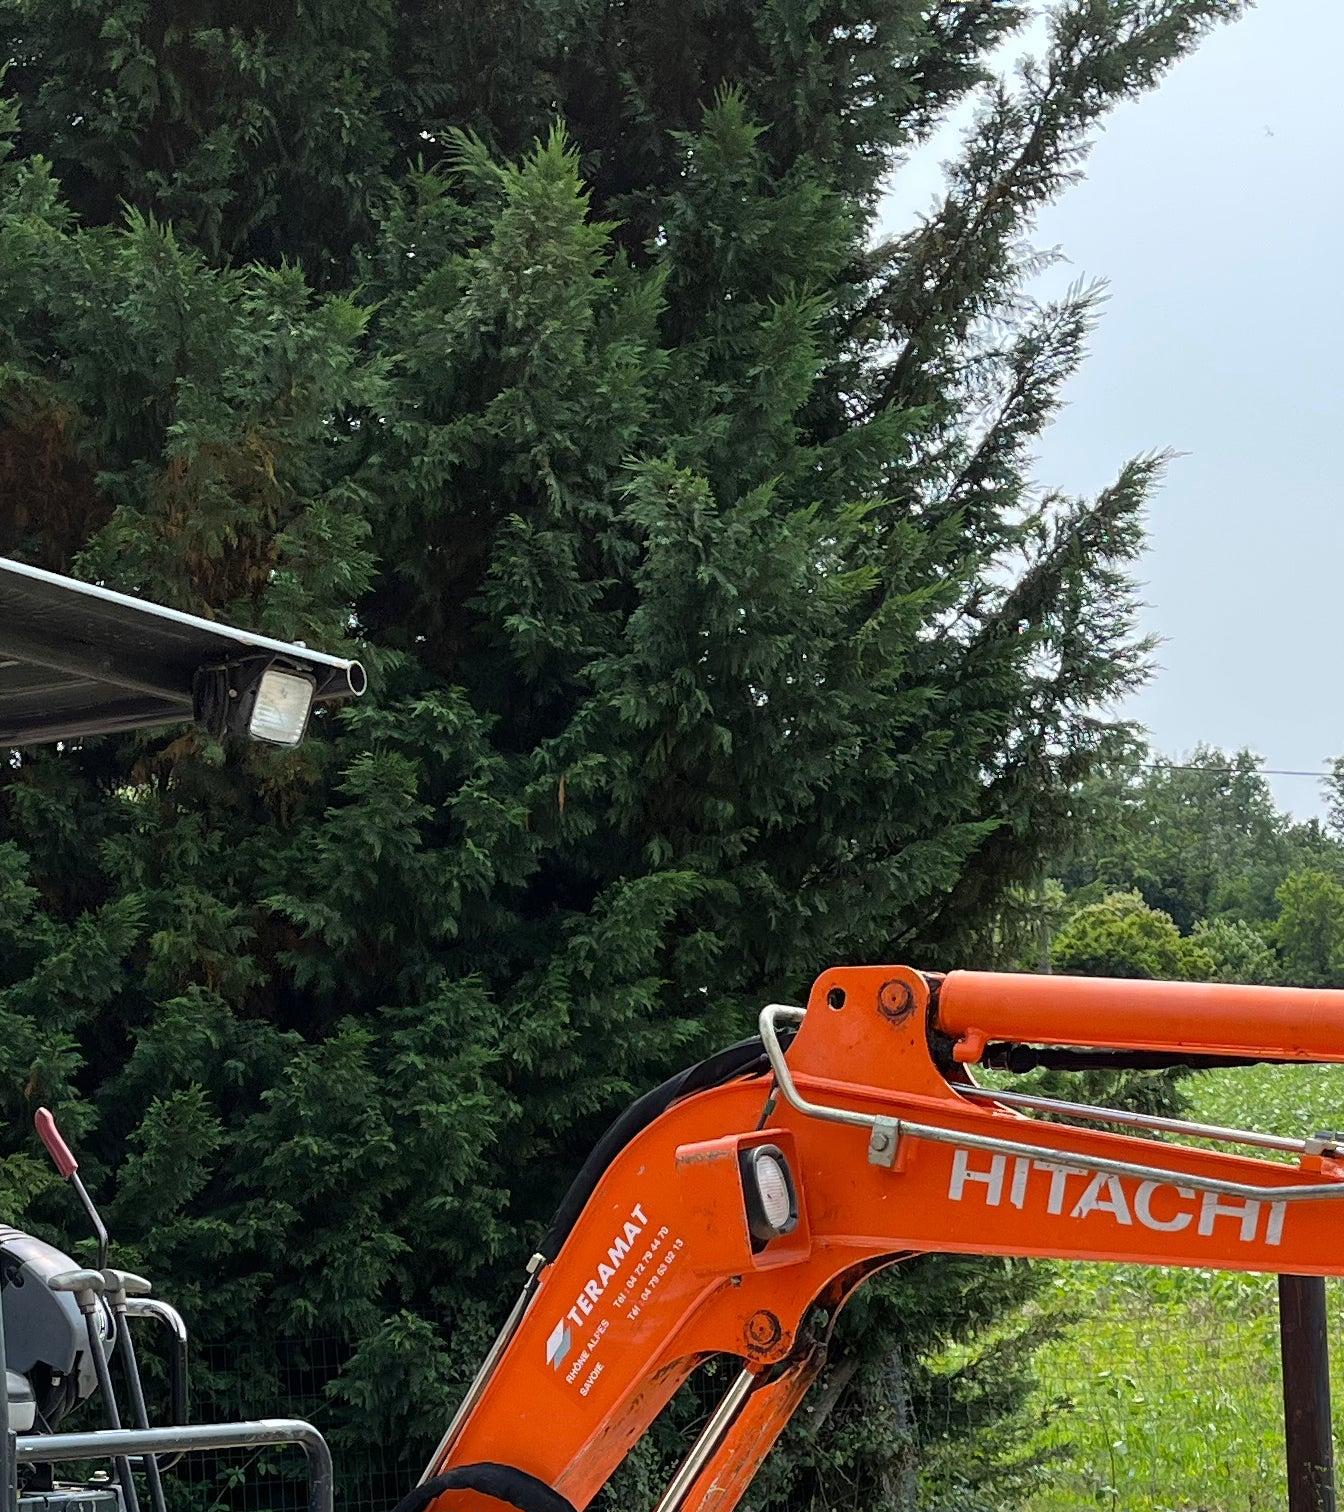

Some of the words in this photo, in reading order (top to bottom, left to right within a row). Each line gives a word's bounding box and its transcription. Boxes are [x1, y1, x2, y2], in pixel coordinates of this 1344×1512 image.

[947, 1150, 1287, 1246] HITACHI
[567, 1202, 649, 1328] TERAMAT
[587, 1318, 610, 1352] ALPES
[626, 1275, 637, 1289] 04
[634, 1263, 646, 1276] 72
[642, 1250, 653, 1264] 79
[650, 1238, 661, 1251] 44
[657, 1226, 669, 1239] 70
[579, 1361, 605, 1397] SAVOIE
[640, 1287, 652, 1301] 04
